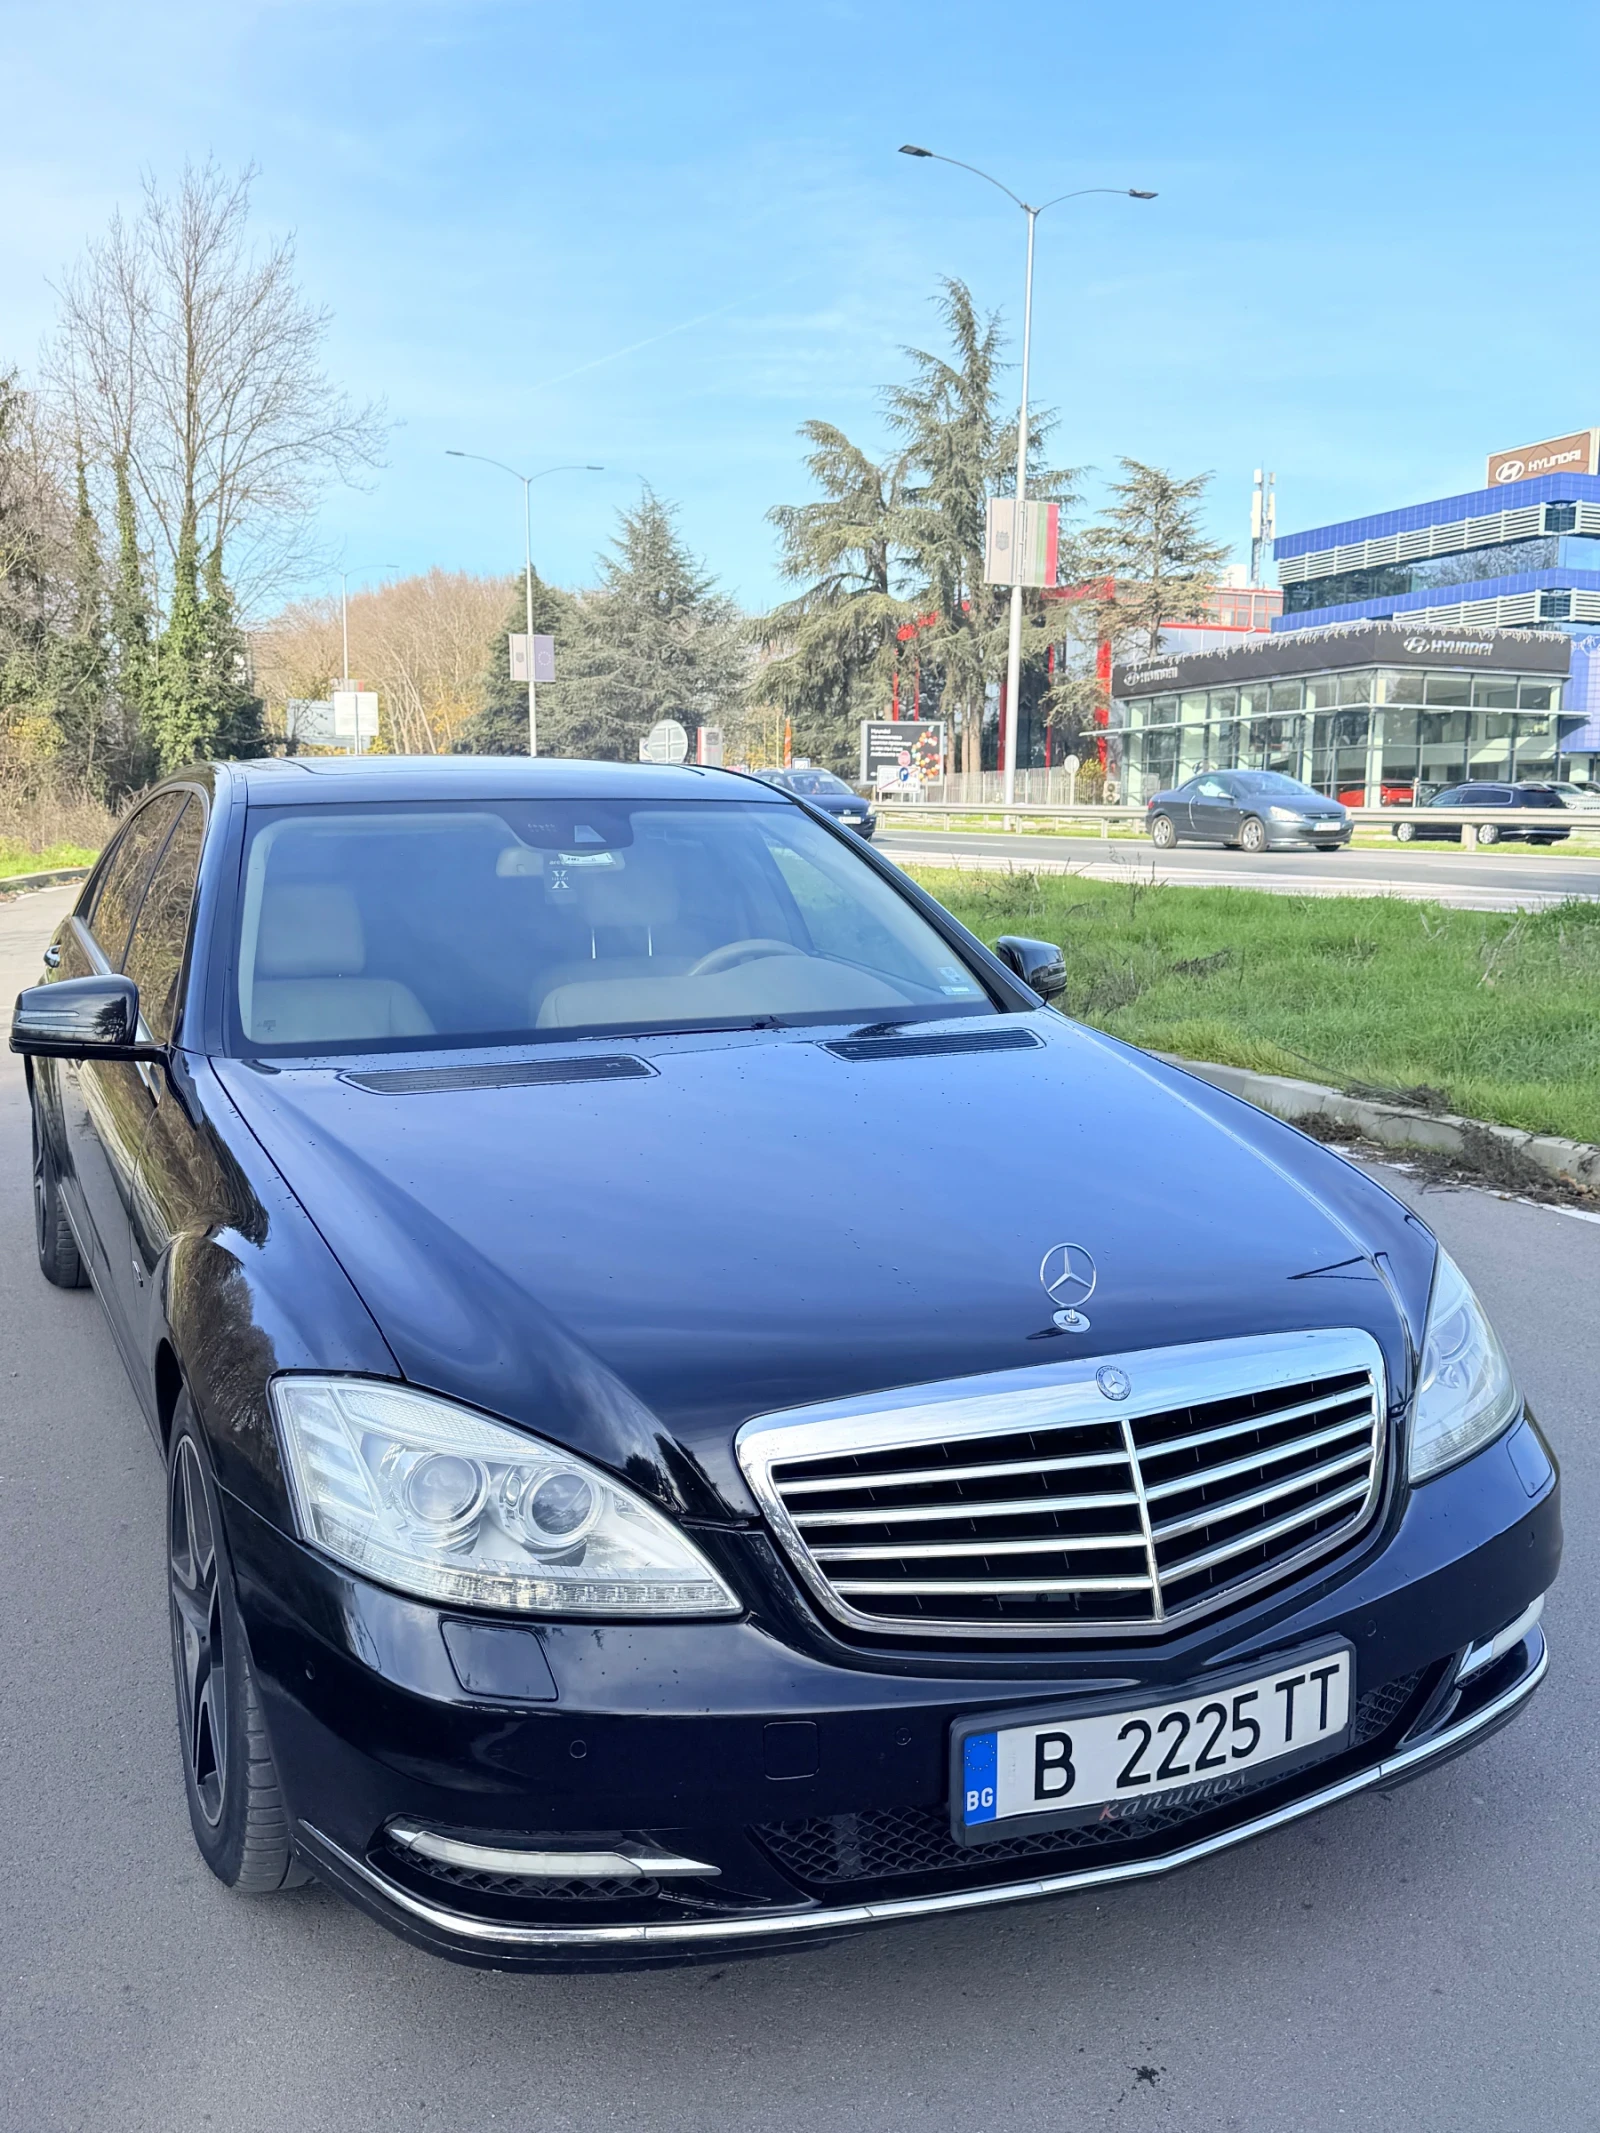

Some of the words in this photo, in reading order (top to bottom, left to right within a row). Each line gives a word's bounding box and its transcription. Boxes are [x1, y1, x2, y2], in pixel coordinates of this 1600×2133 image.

[1528, 449, 1581, 471] HYUNDAI
[1430, 639, 1493, 656] HYUNDAI
[1034, 1731, 1075, 1800] B
[1116, 1690, 1260, 1788] 2225
[1275, 1663, 1340, 1743] TT
[966, 1787, 993, 1812] BG
